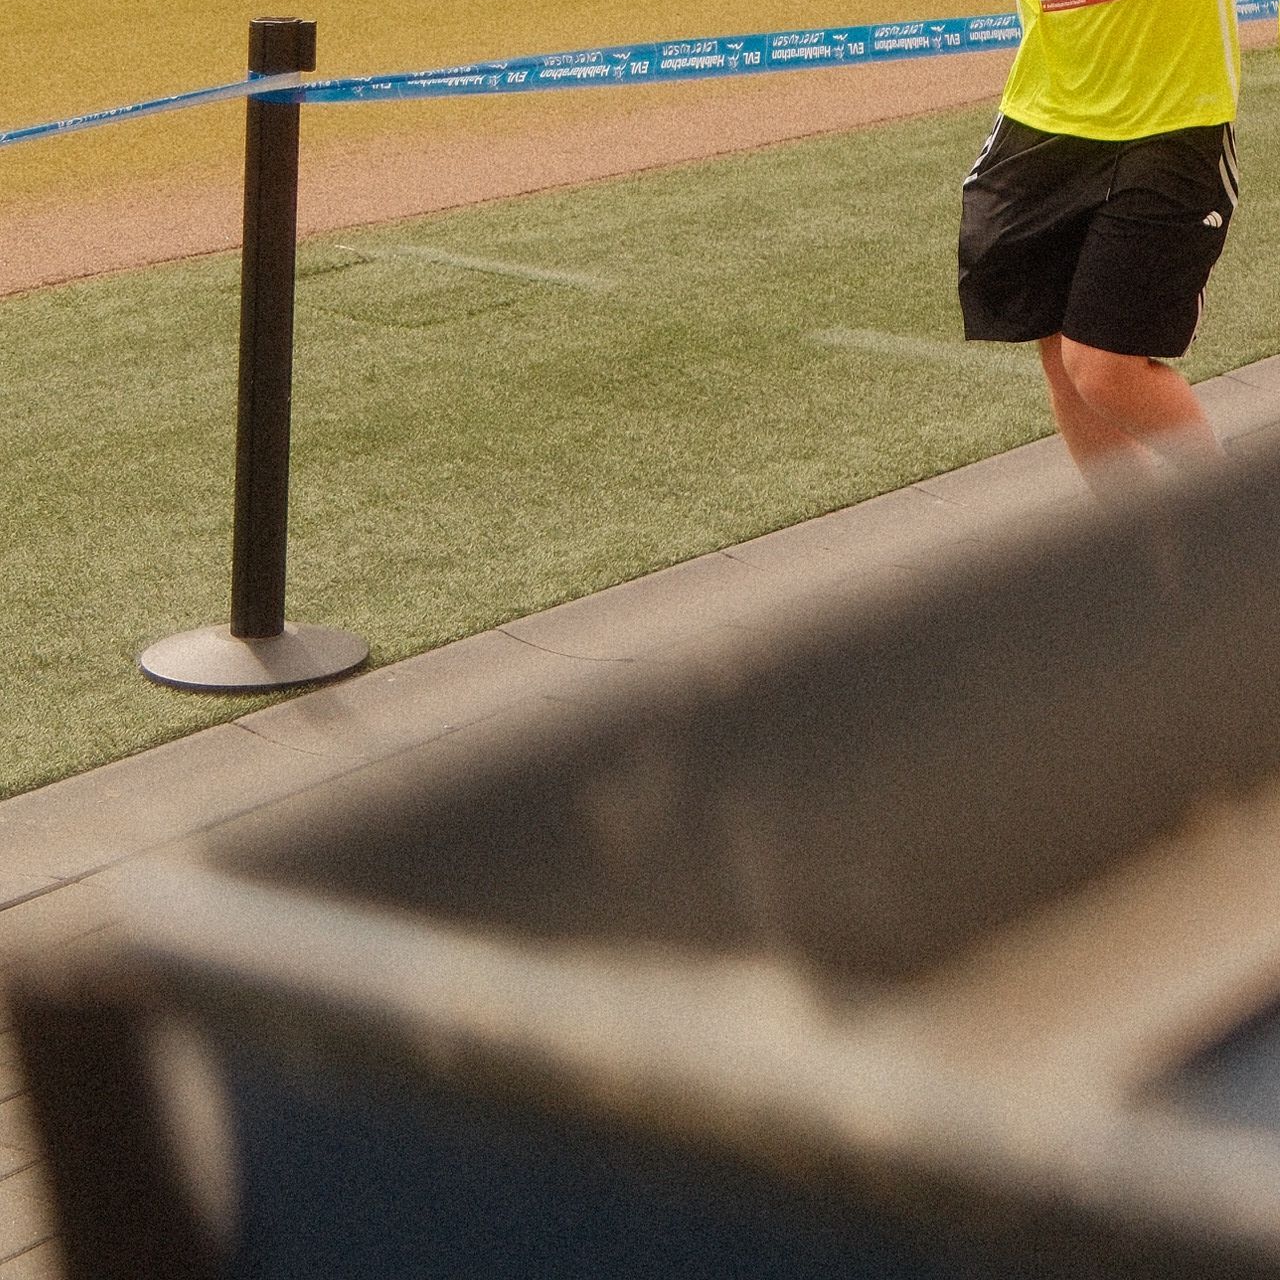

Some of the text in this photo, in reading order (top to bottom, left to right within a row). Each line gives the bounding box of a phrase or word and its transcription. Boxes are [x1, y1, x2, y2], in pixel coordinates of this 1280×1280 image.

[772, 45, 831, 61] HalbMarathon
[661, 53, 725, 71] HalbMarathon
[540, 63, 612, 80] HalbMarathon
